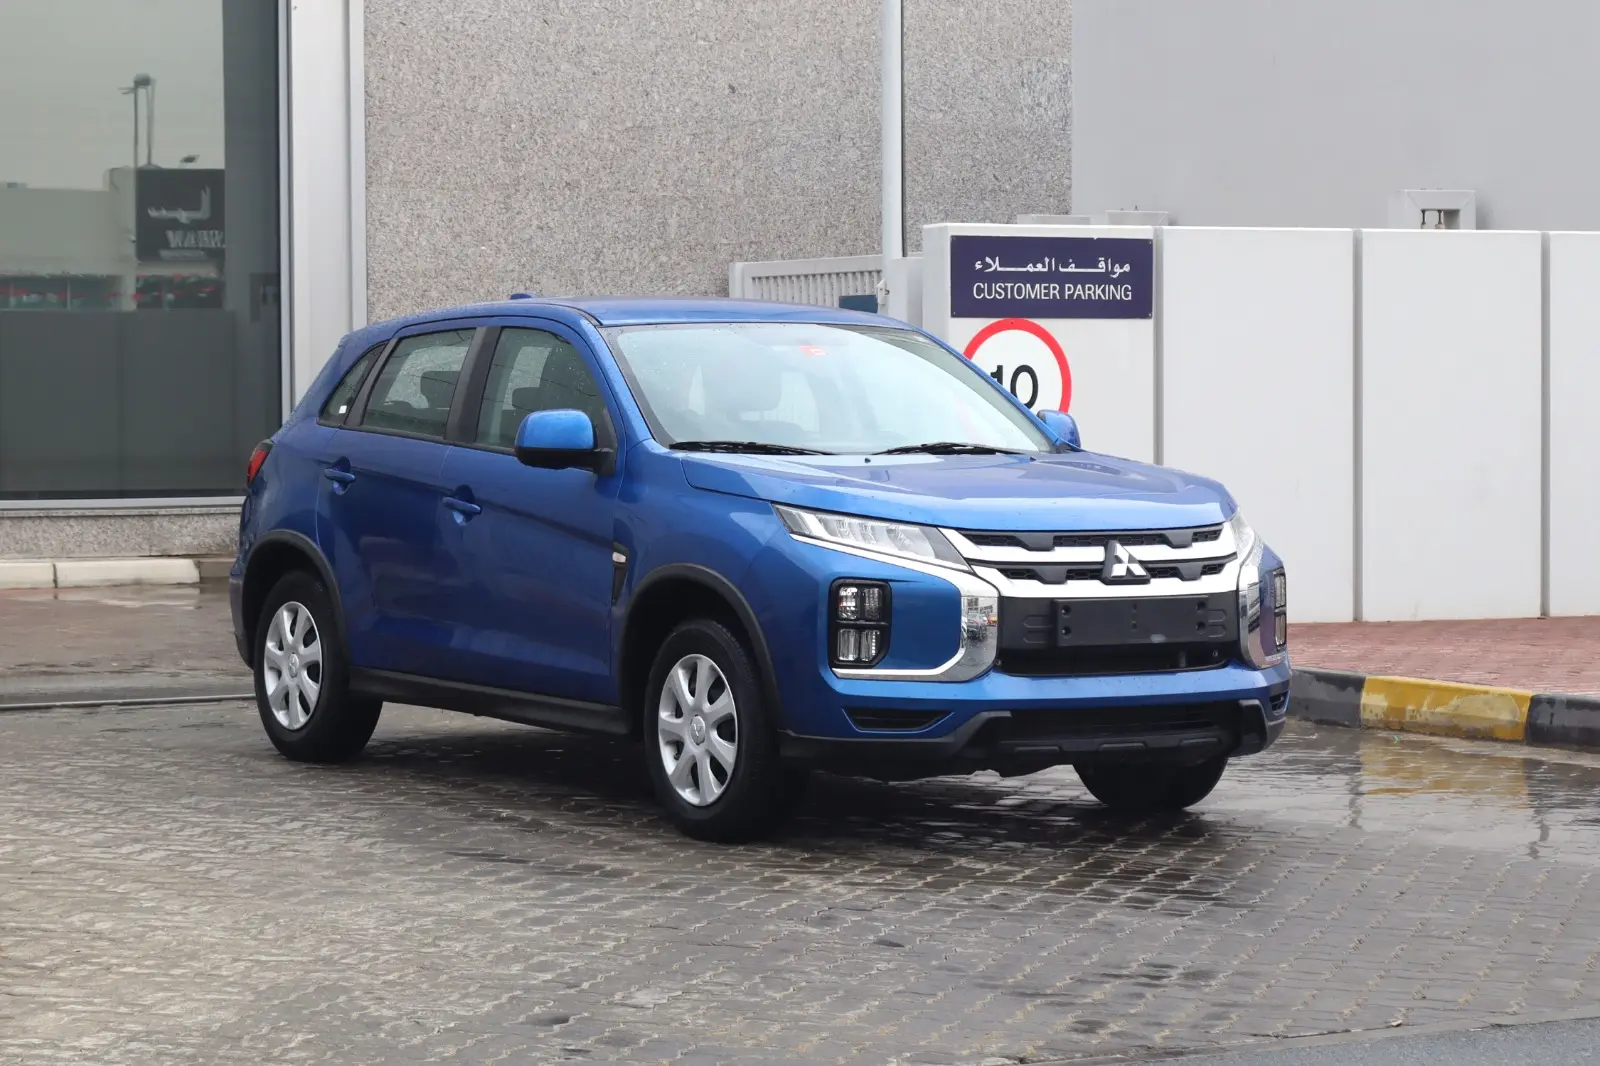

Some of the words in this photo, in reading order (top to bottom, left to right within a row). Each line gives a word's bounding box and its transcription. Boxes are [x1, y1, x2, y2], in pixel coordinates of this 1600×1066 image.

[974, 256, 1056, 273] العملاء
[1058, 257, 1131, 278] مواقف
[973, 282, 1060, 300] CUSTOMER
[1065, 283, 1132, 301] PARKING
